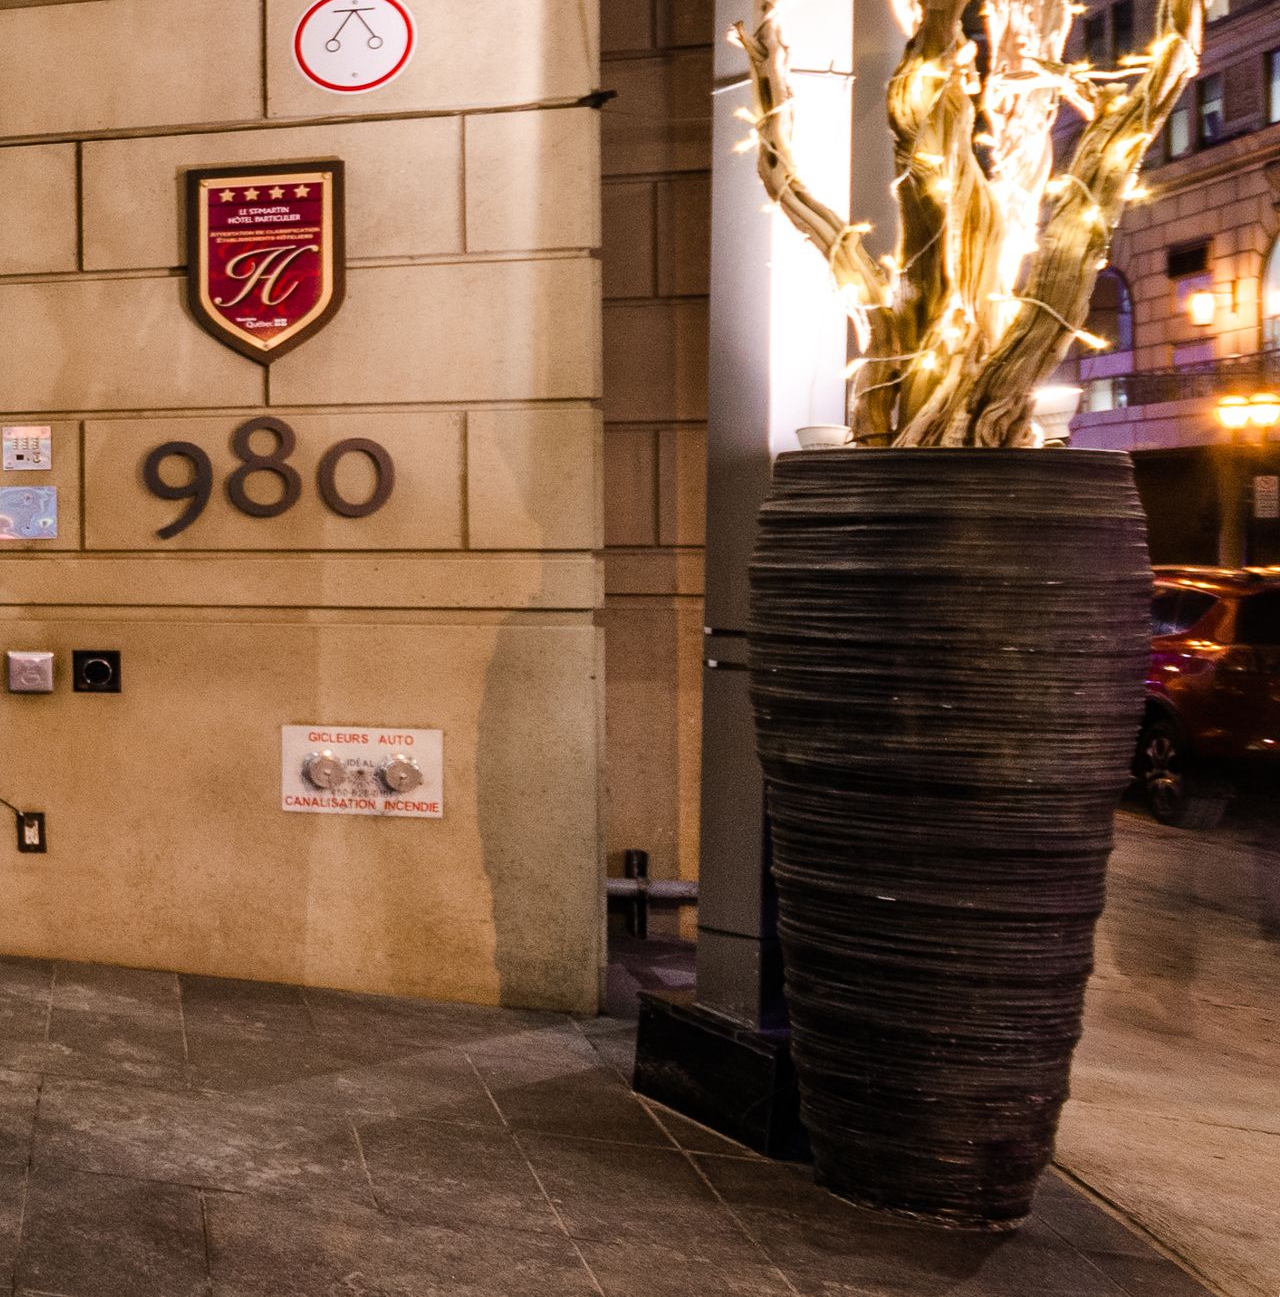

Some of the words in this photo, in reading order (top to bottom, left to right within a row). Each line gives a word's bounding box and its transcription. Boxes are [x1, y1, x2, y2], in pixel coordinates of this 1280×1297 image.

[143, 415, 395, 540] 980
[308, 731, 369, 744] GICLEURS
[378, 734, 414, 746] AUTO
[285, 795, 377, 810] CANALISATION
[383, 799, 440, 813] INCENDIE
